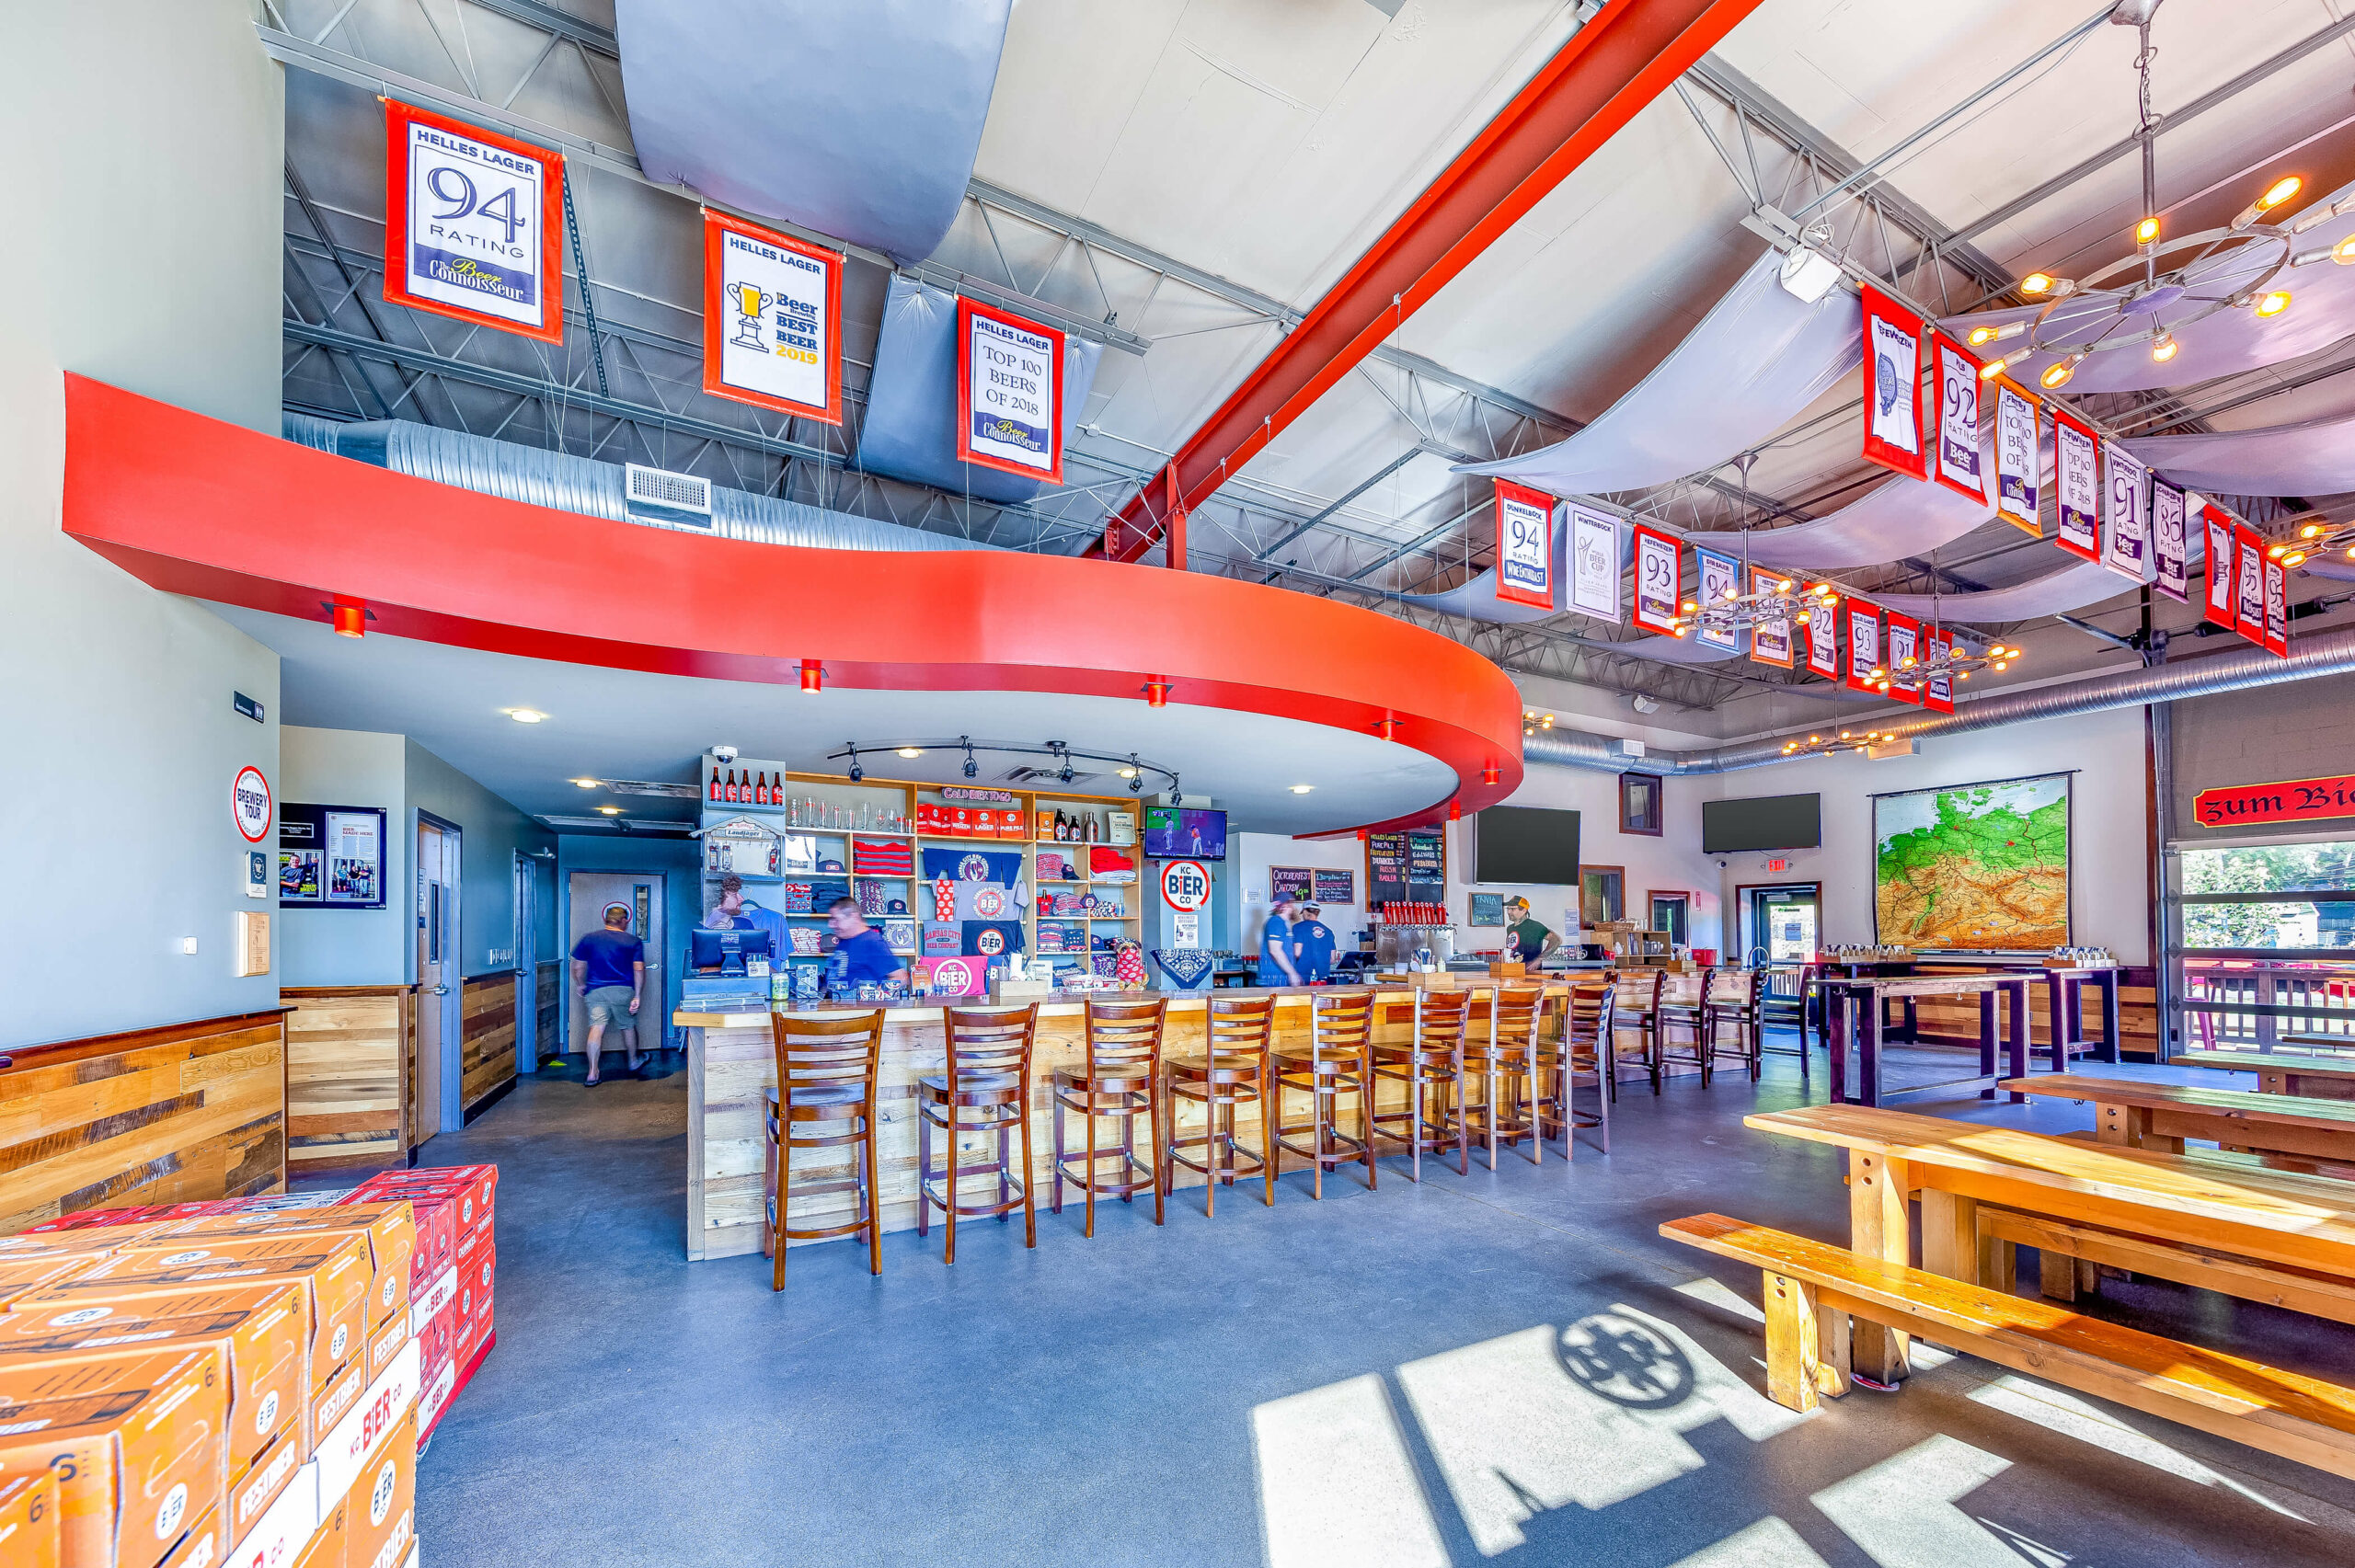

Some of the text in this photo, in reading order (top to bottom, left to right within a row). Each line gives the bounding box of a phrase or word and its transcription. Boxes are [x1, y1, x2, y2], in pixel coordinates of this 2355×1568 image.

[418, 131, 534, 175] HELLES LAGER
[427, 167, 526, 243] 94
[430, 224, 524, 258] RATING
[729, 237, 821, 275] HELLES LAGER
[430, 259, 523, 301] Connoisseur
[451, 258, 502, 283] Beer
[776, 292, 818, 315] Beer
[790, 308, 817, 320] Brewing
[776, 315, 818, 335] BEST
[977, 320, 1049, 350] HELLES LAGER
[776, 330, 818, 350] BEER
[776, 345, 818, 365] 2019
[983, 346, 1042, 376] TOP 100
[990, 368, 1037, 395] BEERS
[986, 389, 1039, 416] OF 2018
[1947, 377, 1976, 429] 92
[983, 421, 1041, 452] Connoisseur
[996, 420, 1028, 438] Beer
[1507, 503, 1542, 521] DUNKELBOCK
[2115, 477, 2138, 525] 91
[1577, 516, 1611, 532] WINTERBOCK
[1511, 521, 1539, 556] 94
[1512, 551, 1539, 565] RATING
[1590, 554, 1605, 566] BEER
[1591, 563, 1604, 573] CUP
[1647, 554, 1671, 587] 93
[1646, 584, 1672, 598] RATING
[1706, 574, 1728, 600] 94
[1814, 607, 1832, 635] 92
[1855, 627, 1871, 651] 93
[237, 787, 268, 808] BREWERY
[944, 787, 969, 799] COLD
[999, 792, 1012, 803] GO
[2204, 781, 2355, 822] zum Bi
[244, 804, 261, 820] TOUR
[1180, 866, 1191, 875] KC
[1373, 857, 1396, 865] DUNKEL
[1769, 859, 1786, 872] EXIT
[1273, 870, 1311, 880] OKTOBERFEST
[1179, 896, 1191, 904] CO
[1475, 896, 1498, 906] TRIVIA
[925, 929, 961, 941] KANSAS CITY
[406, 1210, 411, 1223] 6
[360, 1245, 365, 1261] 6
[458, 1234, 477, 1259] DUNKEL
[292, 1296, 298, 1315] 6
[373, 1317, 407, 1368] FESTBIER
[204, 1366, 214, 1388] 6
[318, 1367, 361, 1432] FESTBIER
[350, 1436, 360, 1459] KC
[393, 1383, 402, 1402] CO
[409, 1408, 415, 1425] 6
[29, 1494, 44, 1523] 6
[335, 1509, 342, 1532] 6
[271, 1537, 284, 1565] CO
